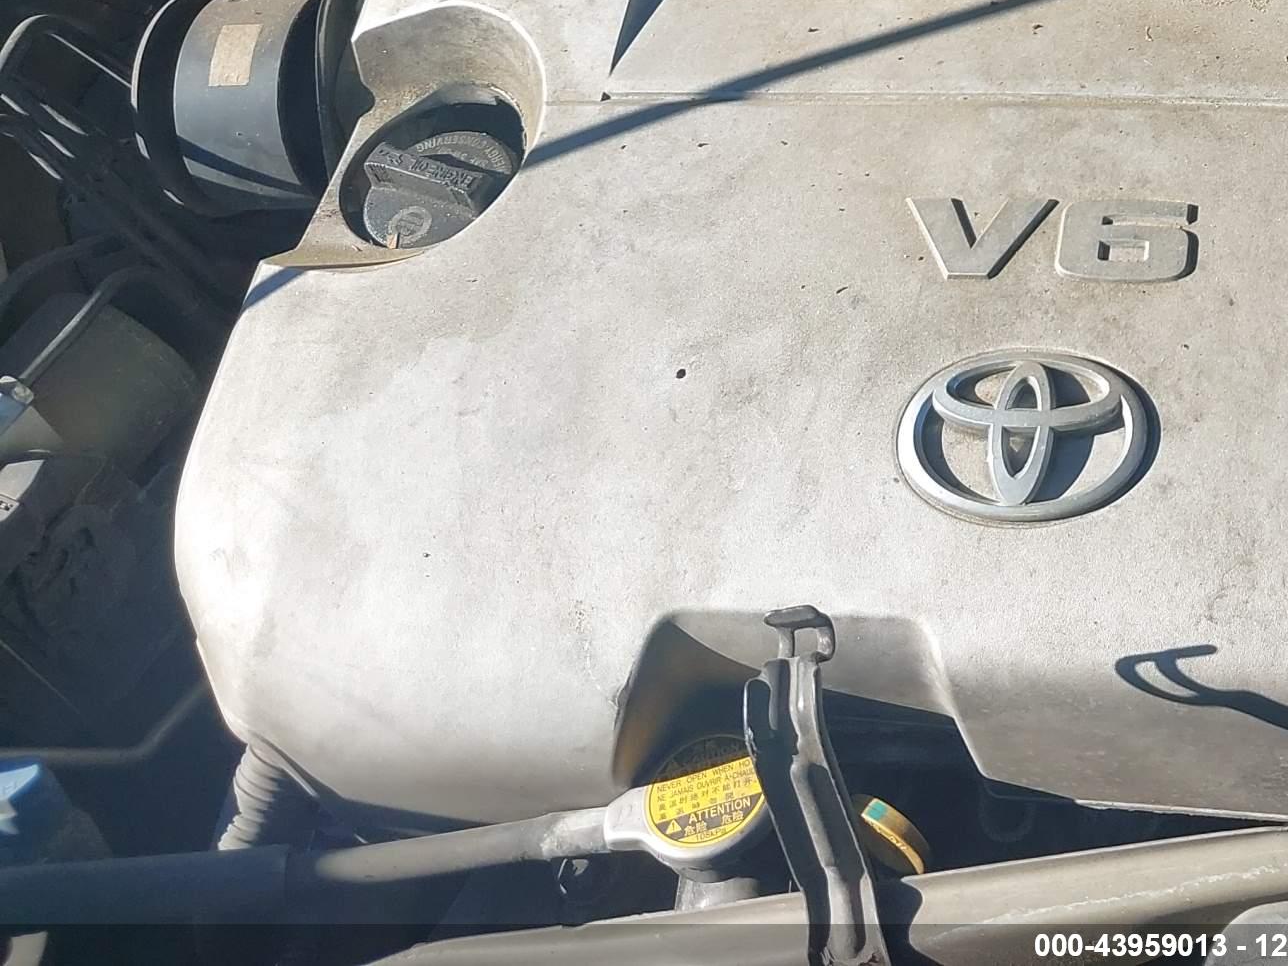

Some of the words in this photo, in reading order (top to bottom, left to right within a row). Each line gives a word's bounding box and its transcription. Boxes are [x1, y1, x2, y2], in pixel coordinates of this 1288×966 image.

[905, 197, 1200, 284] V6
[656, 780, 682, 793] NEVER
[686, 770, 707, 783] OPEN
[712, 762, 734, 776] WHEN
[738, 758, 751, 769] HO
[688, 796, 751, 824] ATTENTION
